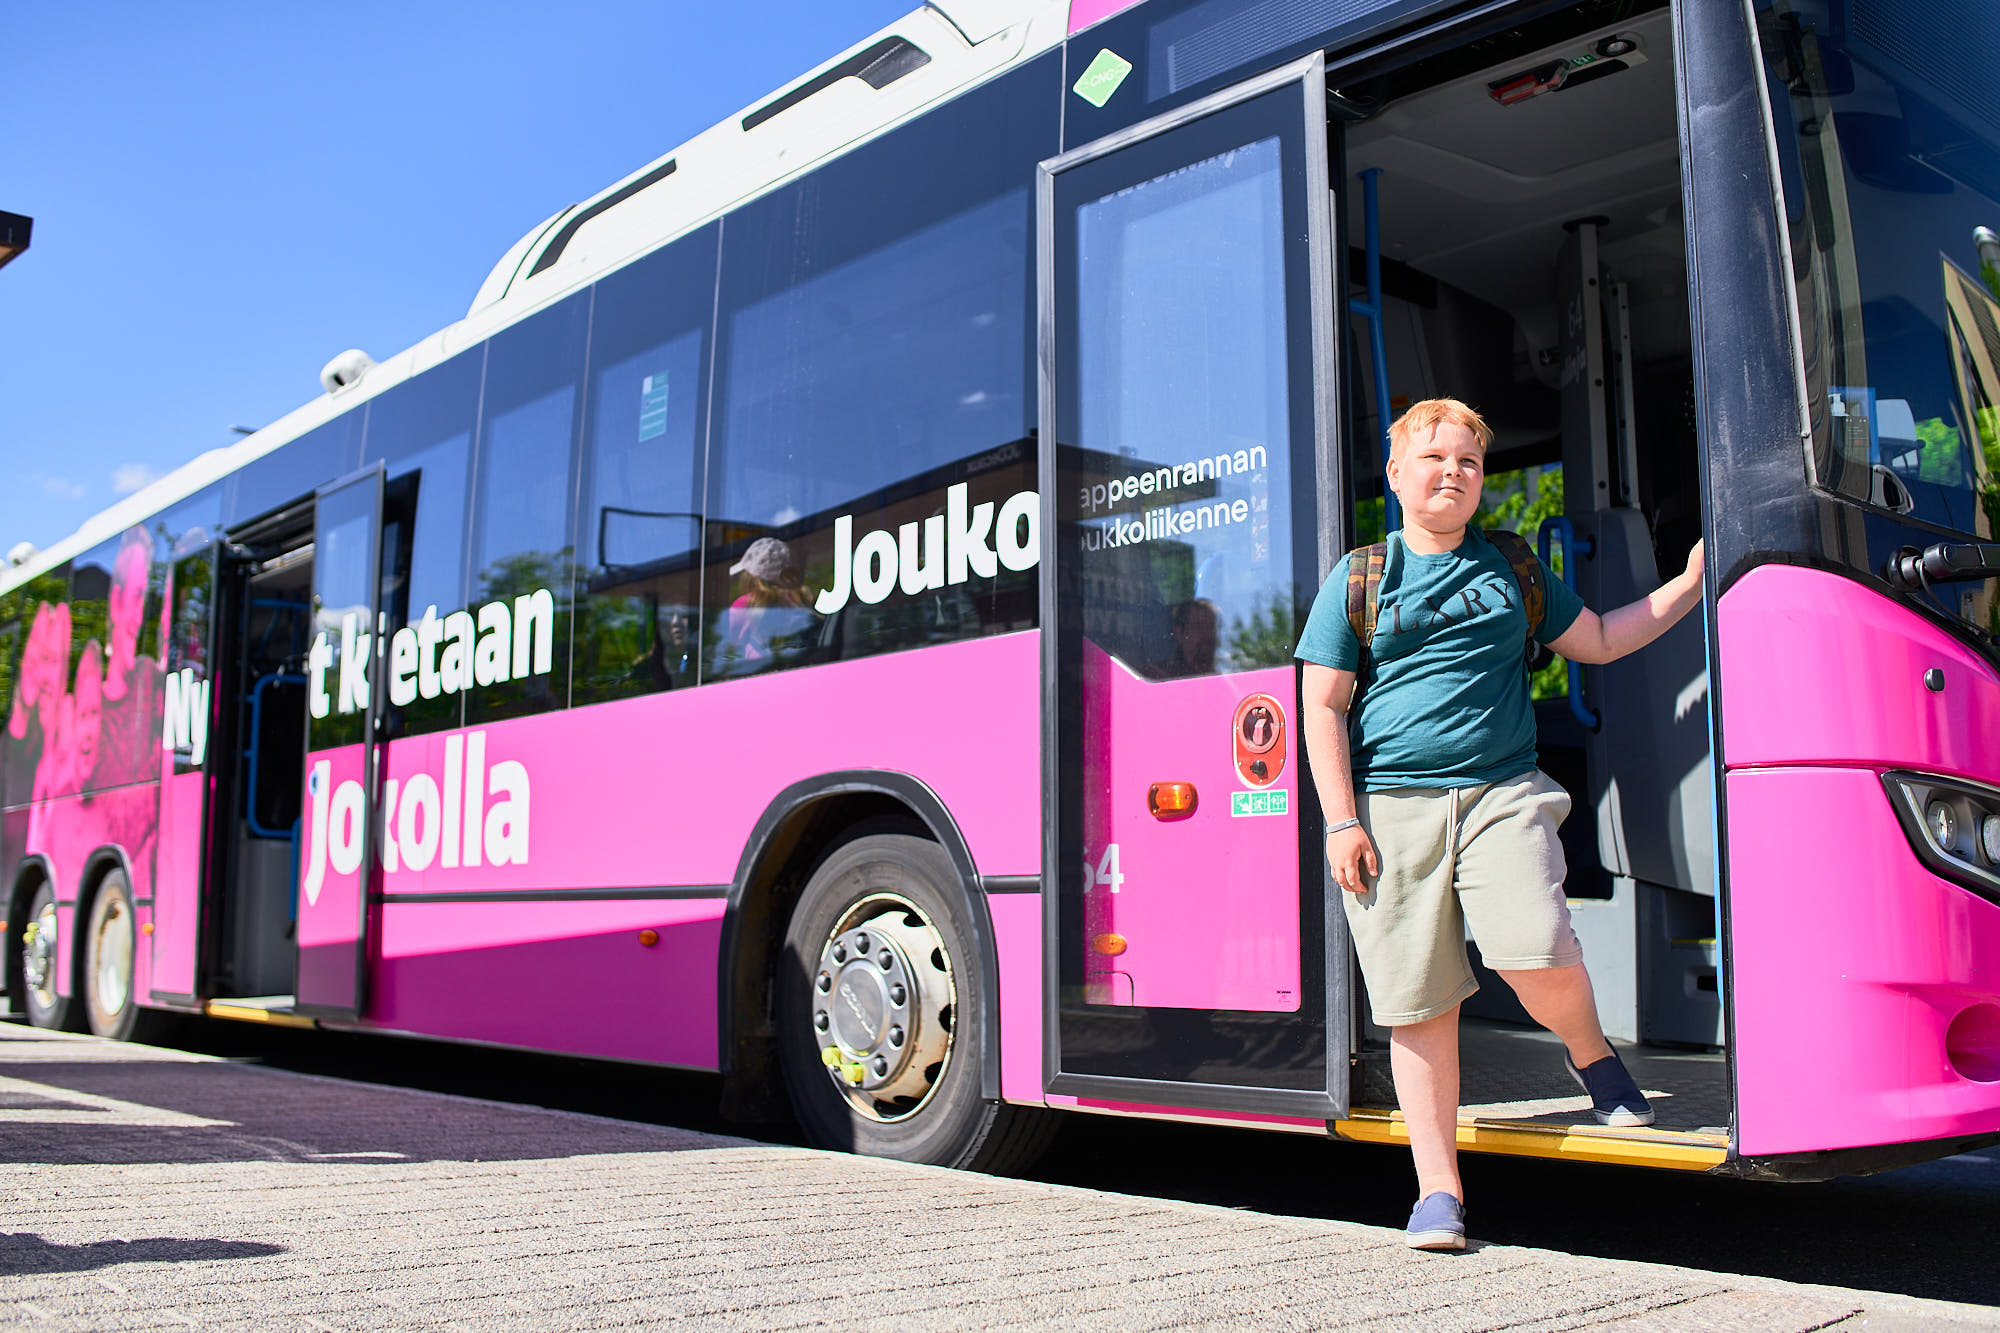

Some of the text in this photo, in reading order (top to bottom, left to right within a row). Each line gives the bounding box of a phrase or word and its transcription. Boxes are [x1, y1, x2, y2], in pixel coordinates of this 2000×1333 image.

[1081, 445, 1267, 512] appeenrannan
[814, 482, 1041, 615] Jouko
[1081, 499, 1249, 552] ukkoliikenne
[1391, 582, 1513, 635] LXRY
